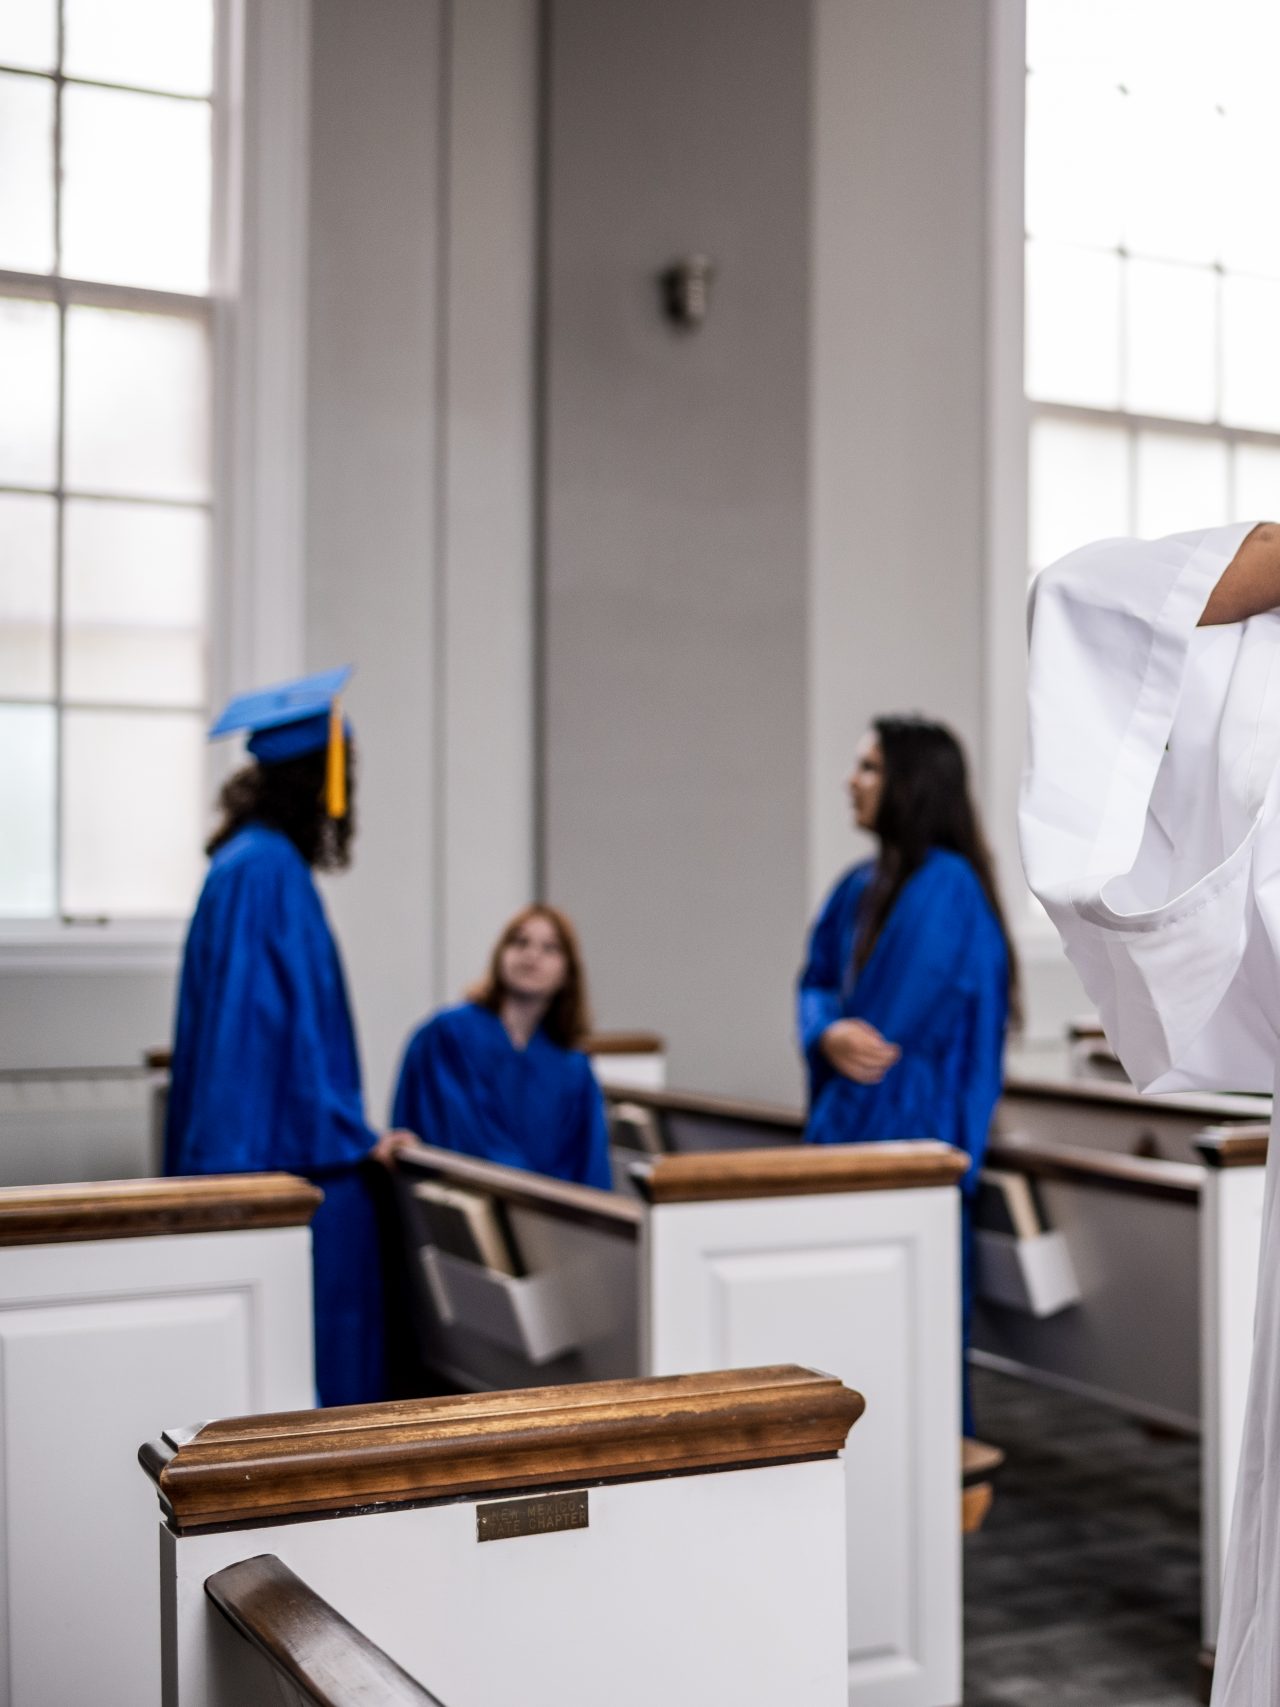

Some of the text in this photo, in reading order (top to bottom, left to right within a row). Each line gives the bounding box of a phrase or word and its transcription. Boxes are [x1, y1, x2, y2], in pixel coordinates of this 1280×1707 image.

[492, 1501, 576, 1521] NEW MEXICO
[529, 1511, 587, 1530] CHAPTER
